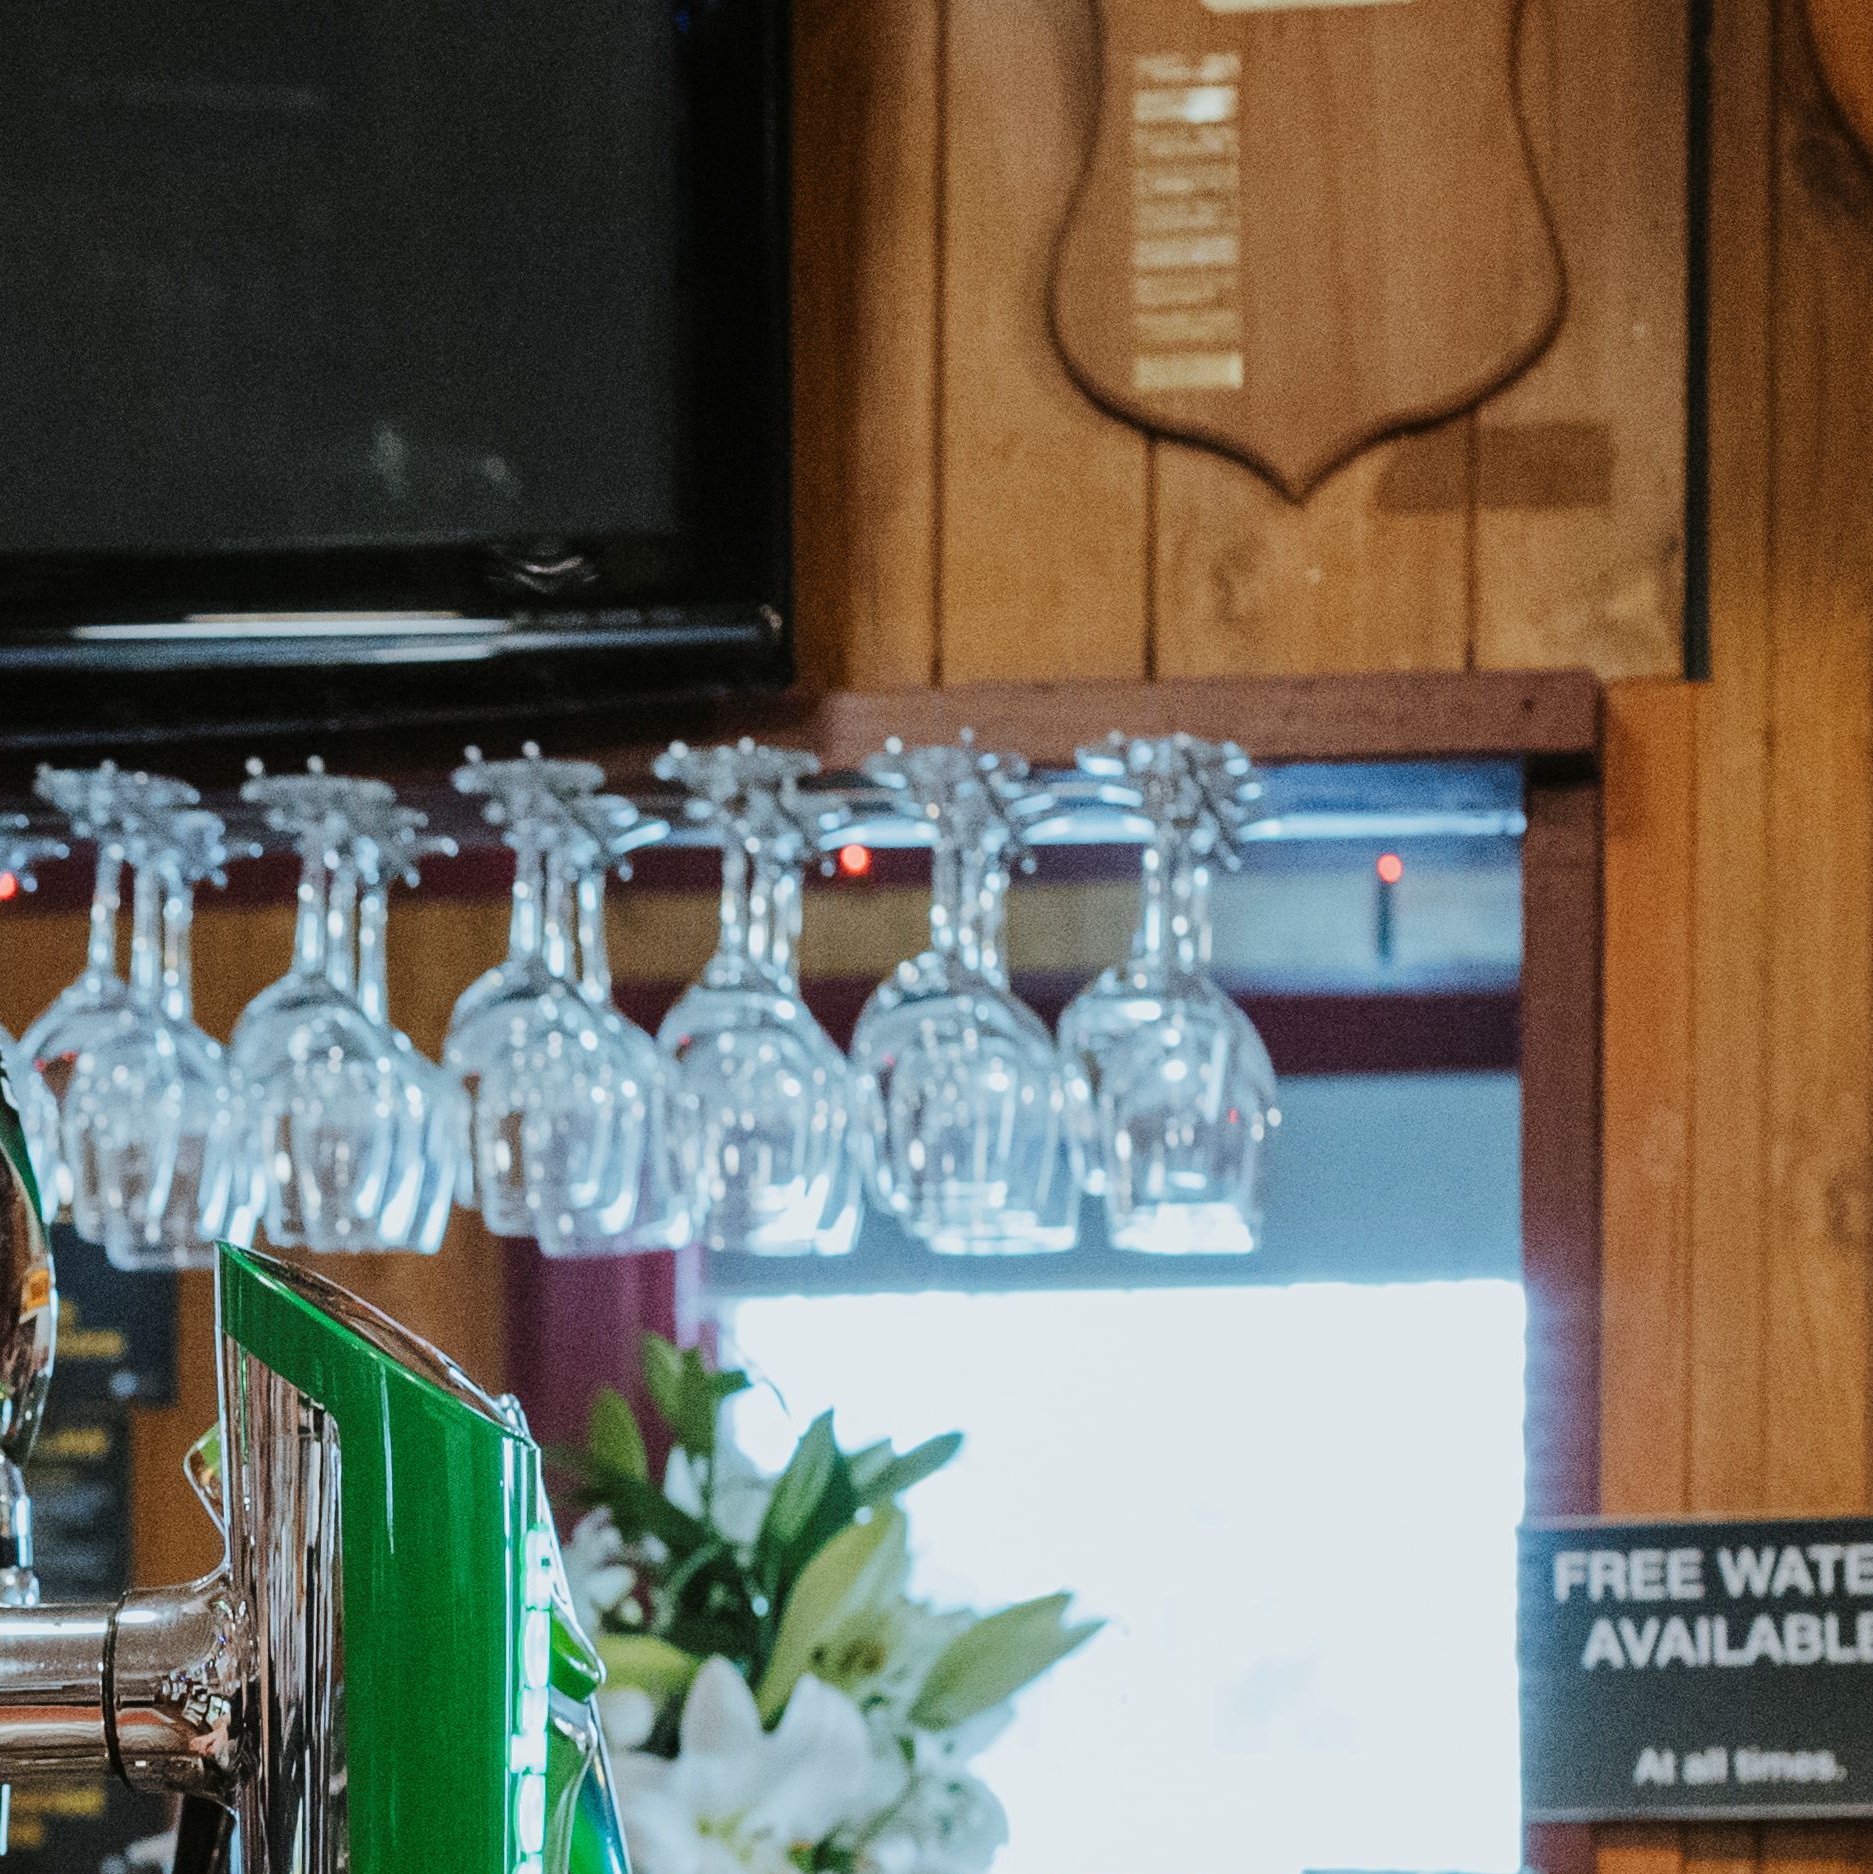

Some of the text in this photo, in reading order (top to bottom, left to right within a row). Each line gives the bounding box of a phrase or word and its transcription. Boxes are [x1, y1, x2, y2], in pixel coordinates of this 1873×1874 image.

[1554, 1542, 1873, 1602] FREE WATE
[1634, 1746, 1676, 1787] At
